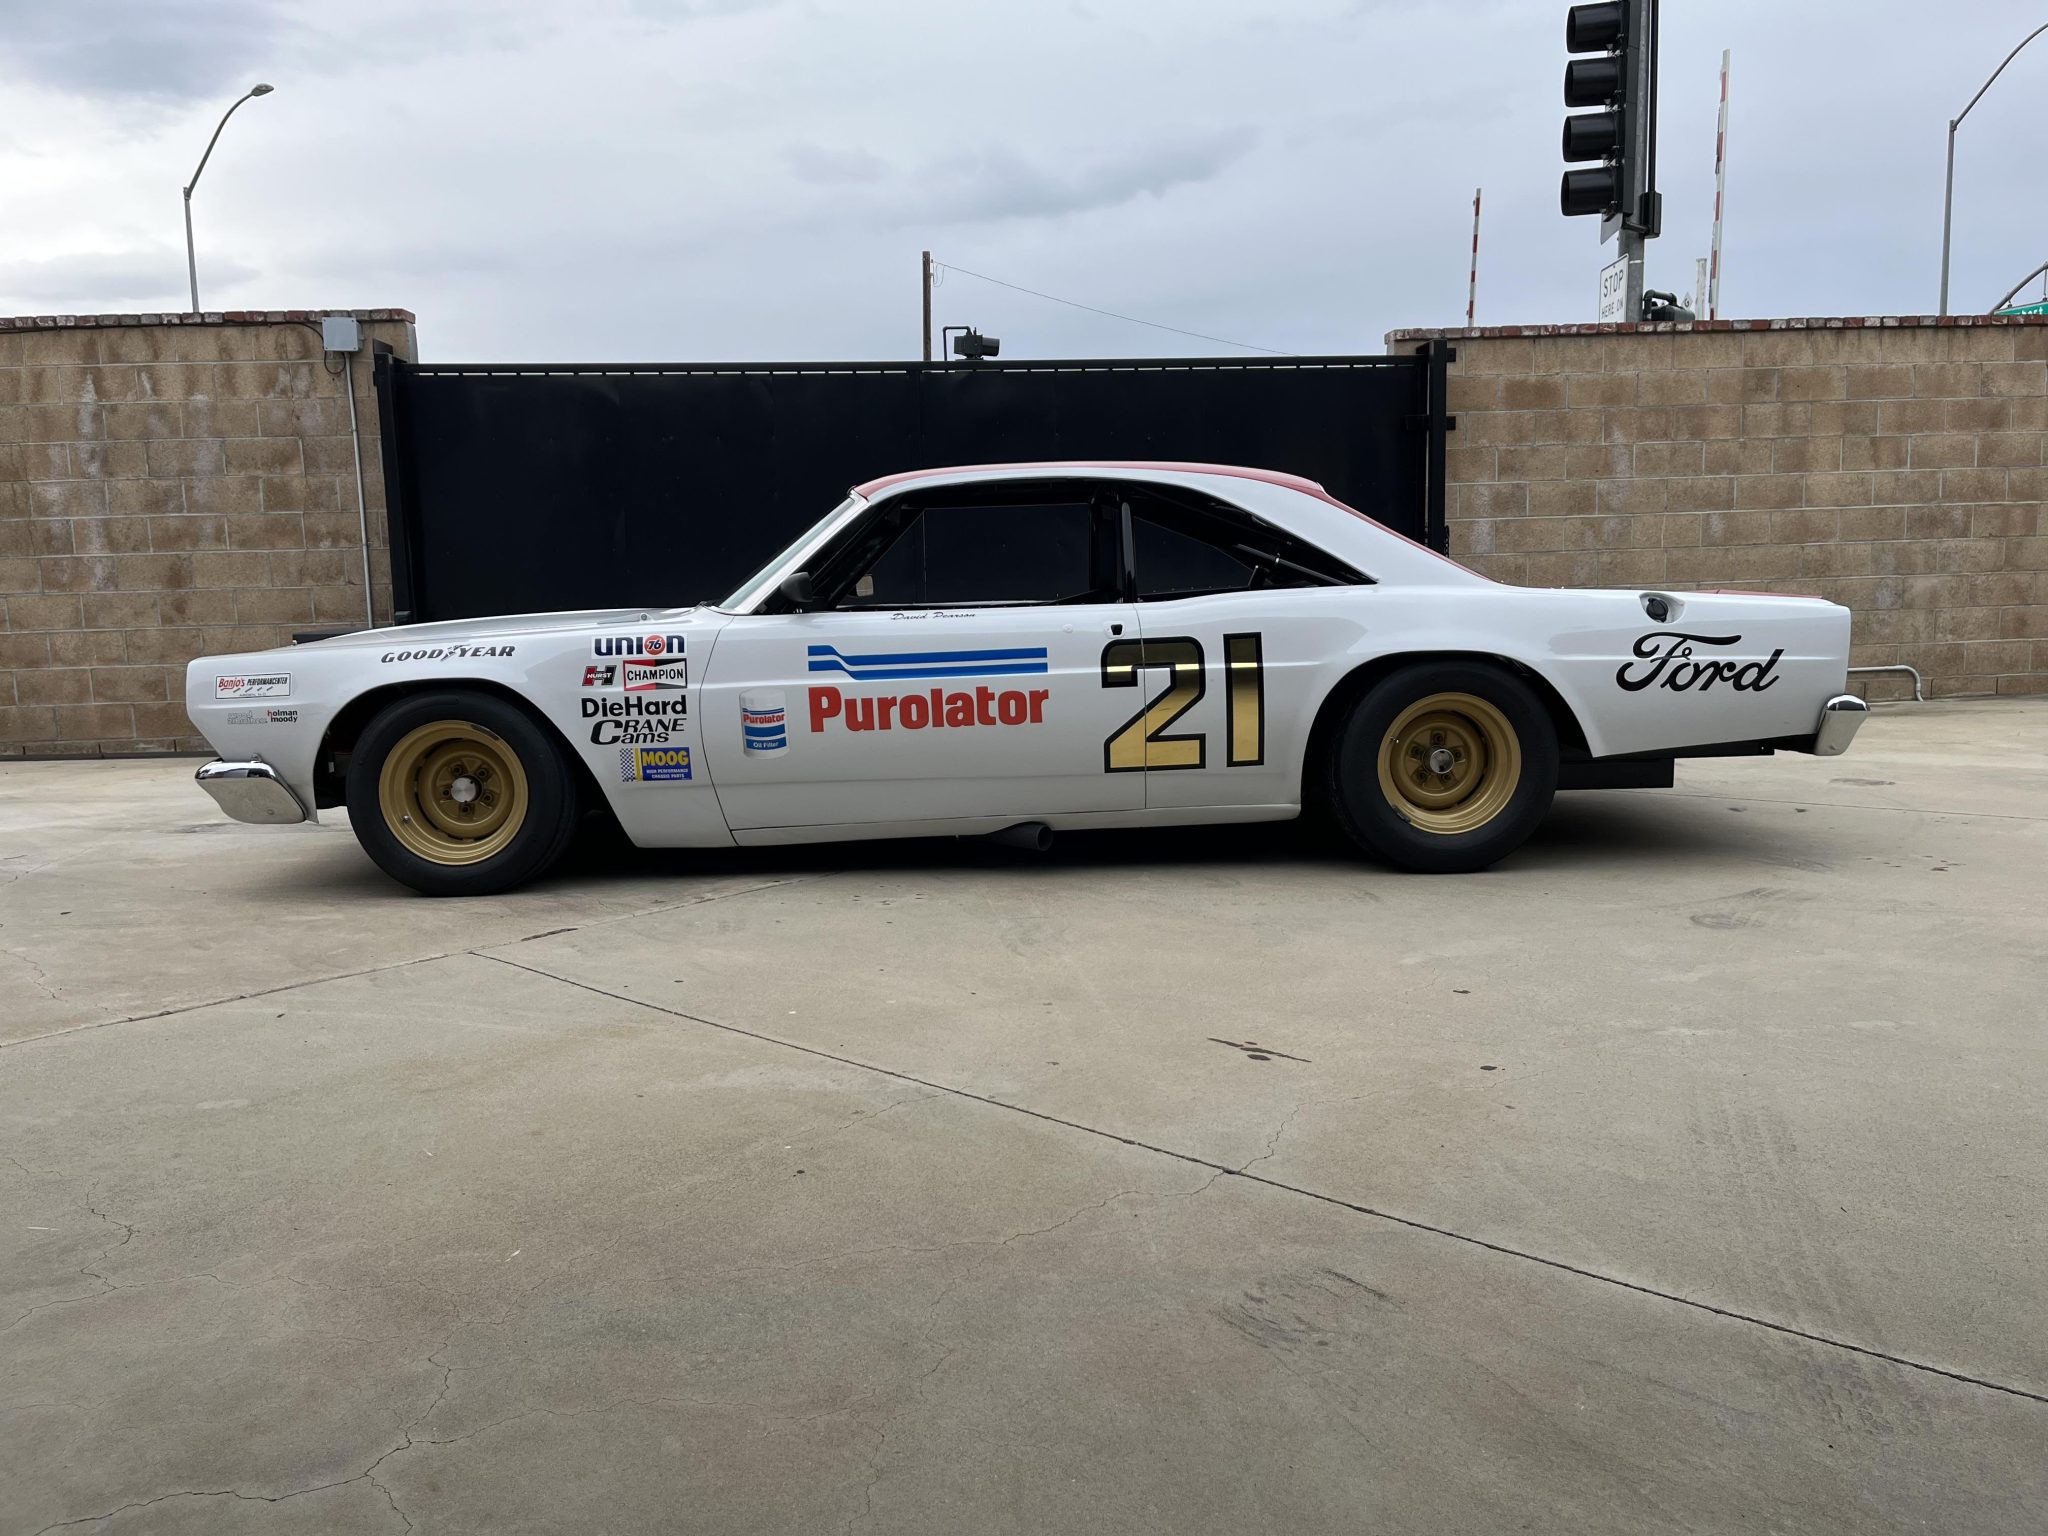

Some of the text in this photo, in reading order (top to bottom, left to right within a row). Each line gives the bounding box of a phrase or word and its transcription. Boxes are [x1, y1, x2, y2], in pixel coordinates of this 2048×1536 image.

[1603, 269, 1624, 298] STOP
[1601, 301, 1615, 319] HERE
[890, 611, 976, 621] David Pearson
[647, 639, 662, 650] 76
[1615, 631, 1785, 692] Ford
[586, 671, 612, 679] HURST
[627, 668, 684, 681] CHAMPION
[218, 677, 245, 691] Banjo's
[581, 694, 687, 718] DieHard
[808, 685, 1049, 733] Purolator
[1100, 631, 1265, 774] 21
[267, 709, 298, 717] holman
[270, 715, 298, 723] moody
[743, 713, 785, 724] Purolator
[642, 750, 689, 767] MOOG
